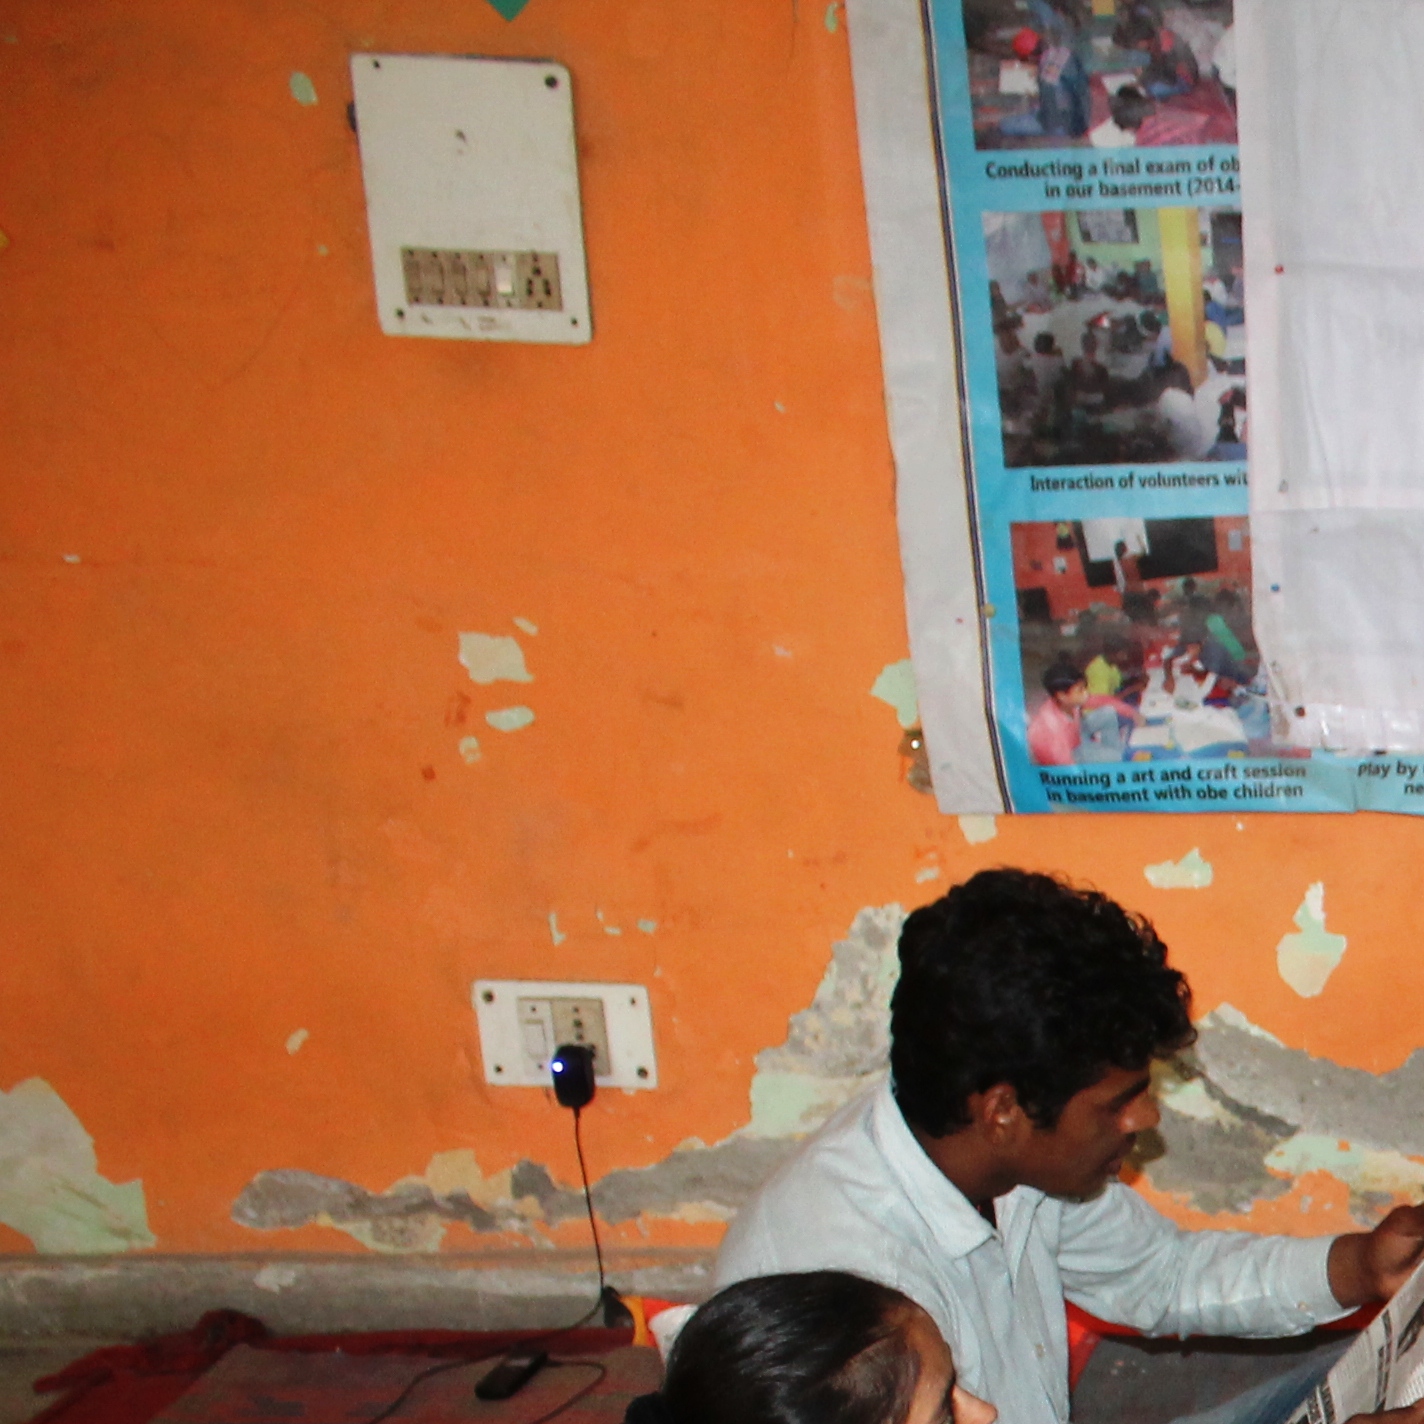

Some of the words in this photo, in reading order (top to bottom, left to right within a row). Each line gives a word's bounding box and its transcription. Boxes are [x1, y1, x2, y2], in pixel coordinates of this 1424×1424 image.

[985, 159, 1082, 181] Conducting
[1088, 162, 1098, 177] a
[1103, 159, 1141, 176] final
[1146, 160, 1192, 175] exam
[1196, 157, 1215, 173] of
[1045, 182, 1061, 198] in
[1066, 184, 1093, 198] our
[1099, 181, 1181, 197] basement
[1031, 473, 1114, 492] Interaction
[1118, 472, 1134, 490] of
[1138, 472, 1219, 489] volunteers
[1039, 770, 1111, 790] Running
[1116, 770, 1128, 784] a
[1131, 767, 1155, 783] art
[1160, 766, 1192, 782] and
[1197, 765, 1237, 782] craft
[1243, 764, 1307, 780] session
[1396, 760, 1418, 780] by
[1046, 789, 1062, 803] in
[1066, 787, 1149, 803] basement
[1153, 784, 1192, 801] with
[1196, 784, 1228, 800] obe
[1233, 781, 1304, 799] children
